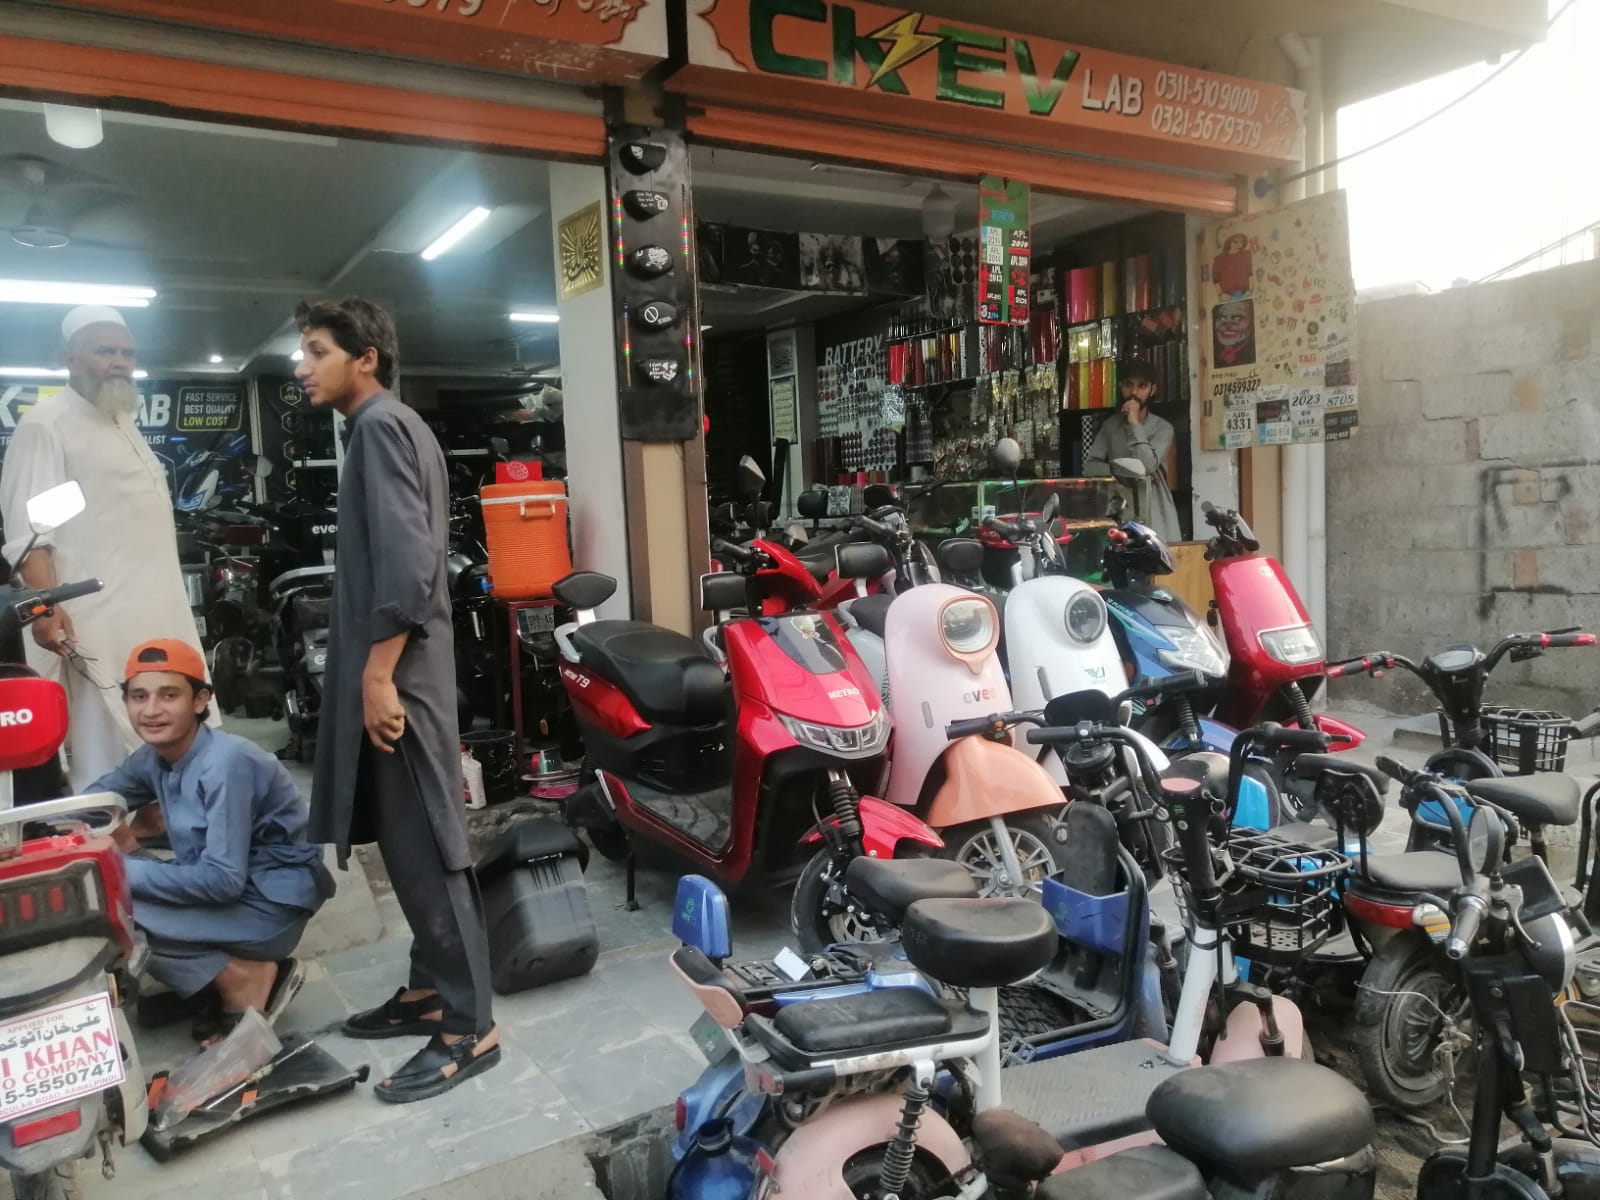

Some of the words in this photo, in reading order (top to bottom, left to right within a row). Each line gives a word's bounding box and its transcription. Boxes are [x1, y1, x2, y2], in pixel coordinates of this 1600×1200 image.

[1082, 69, 1144, 116] LAB
[824, 334, 883, 367] BATTERY
[185, 392, 204, 402] FAST
[206, 392, 237, 402] SERVICE
[184, 404, 203, 415] BEST
[205, 404, 236, 415] QUALITY
[183, 416, 203, 427] LOW
[206, 416, 228, 426] COST
[1225, 417, 1252, 431] 4331
[312, 523, 338, 535] eve
[827, 687, 860, 700] METRO
[24, 1027, 114, 1071] KHAN
[22, 1048, 110, 1084] COMPANY
[0, 1059, 116, 1107] 5-5550747
